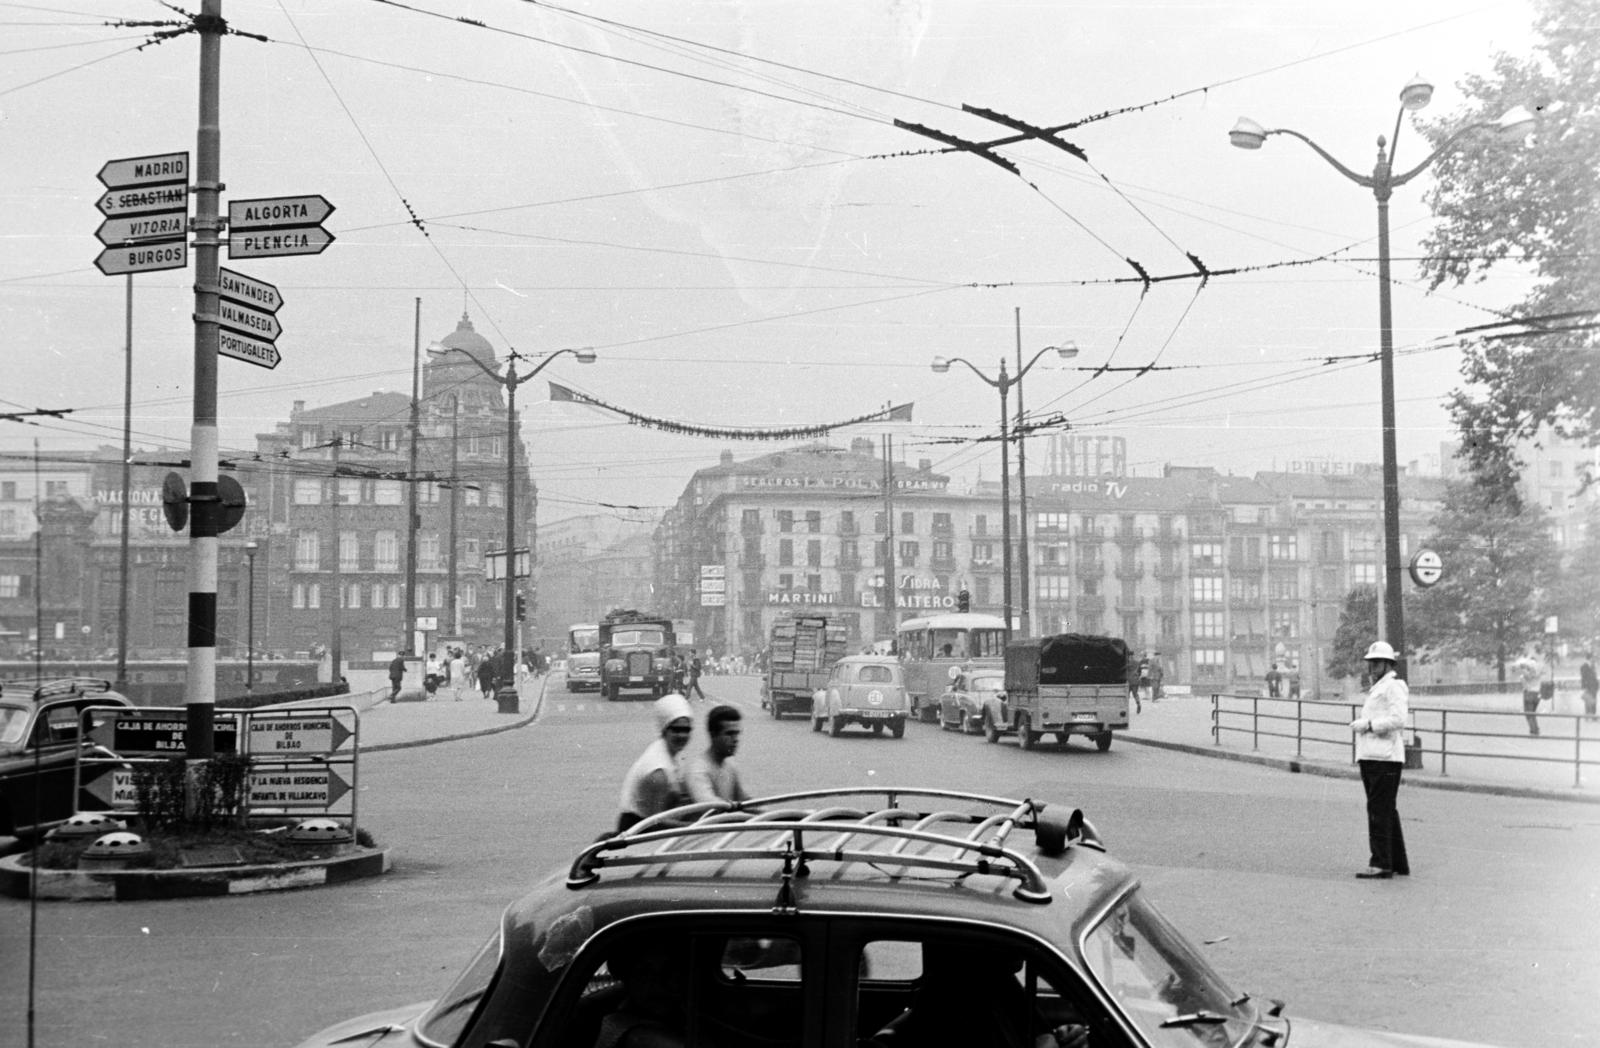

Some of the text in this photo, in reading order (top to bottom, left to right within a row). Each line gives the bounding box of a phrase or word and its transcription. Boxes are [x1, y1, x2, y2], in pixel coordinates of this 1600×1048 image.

[134, 160, 184, 178] MADRID
[105, 188, 183, 210] S. SEBASTIAN
[245, 204, 308, 221] ALGORTA
[129, 218, 181, 235] VITORIA
[244, 234, 309, 251] PLENCIA
[128, 248, 182, 266] BURGOS
[222, 276, 275, 305] SANTANDER
[221, 305, 273, 334] VALMASEDA
[221, 334, 275, 364] PORTUGALETE
[743, 477, 799, 487] SEGUROS
[832, 477, 884, 489] POLA
[1052, 481, 1129, 499] radio TV
[899, 575, 941, 589] SIDRA
[768, 592, 834, 604] MARTINI
[861, 592, 955, 608] EL AITERO
[168, 670, 263, 683] BIBAO
[117, 721, 141, 731] CAJA
[143, 722, 153, 731] DE
[155, 722, 187, 731] AHORR
[251, 722, 332, 732] CAJA DE AHORROS MUNICIPAL
[171, 732, 183, 741] DE
[285, 732, 294, 740] DE
[155, 740, 186, 750] BILBA
[276, 740, 302, 749] BILBAO
[258, 776, 267, 786] LA
[269, 776, 292, 786] NUEVA
[293, 775, 329, 785] RESIDENCIA
[279, 791, 286, 801] DE
[288, 791, 327, 801] VILLARCAYO
